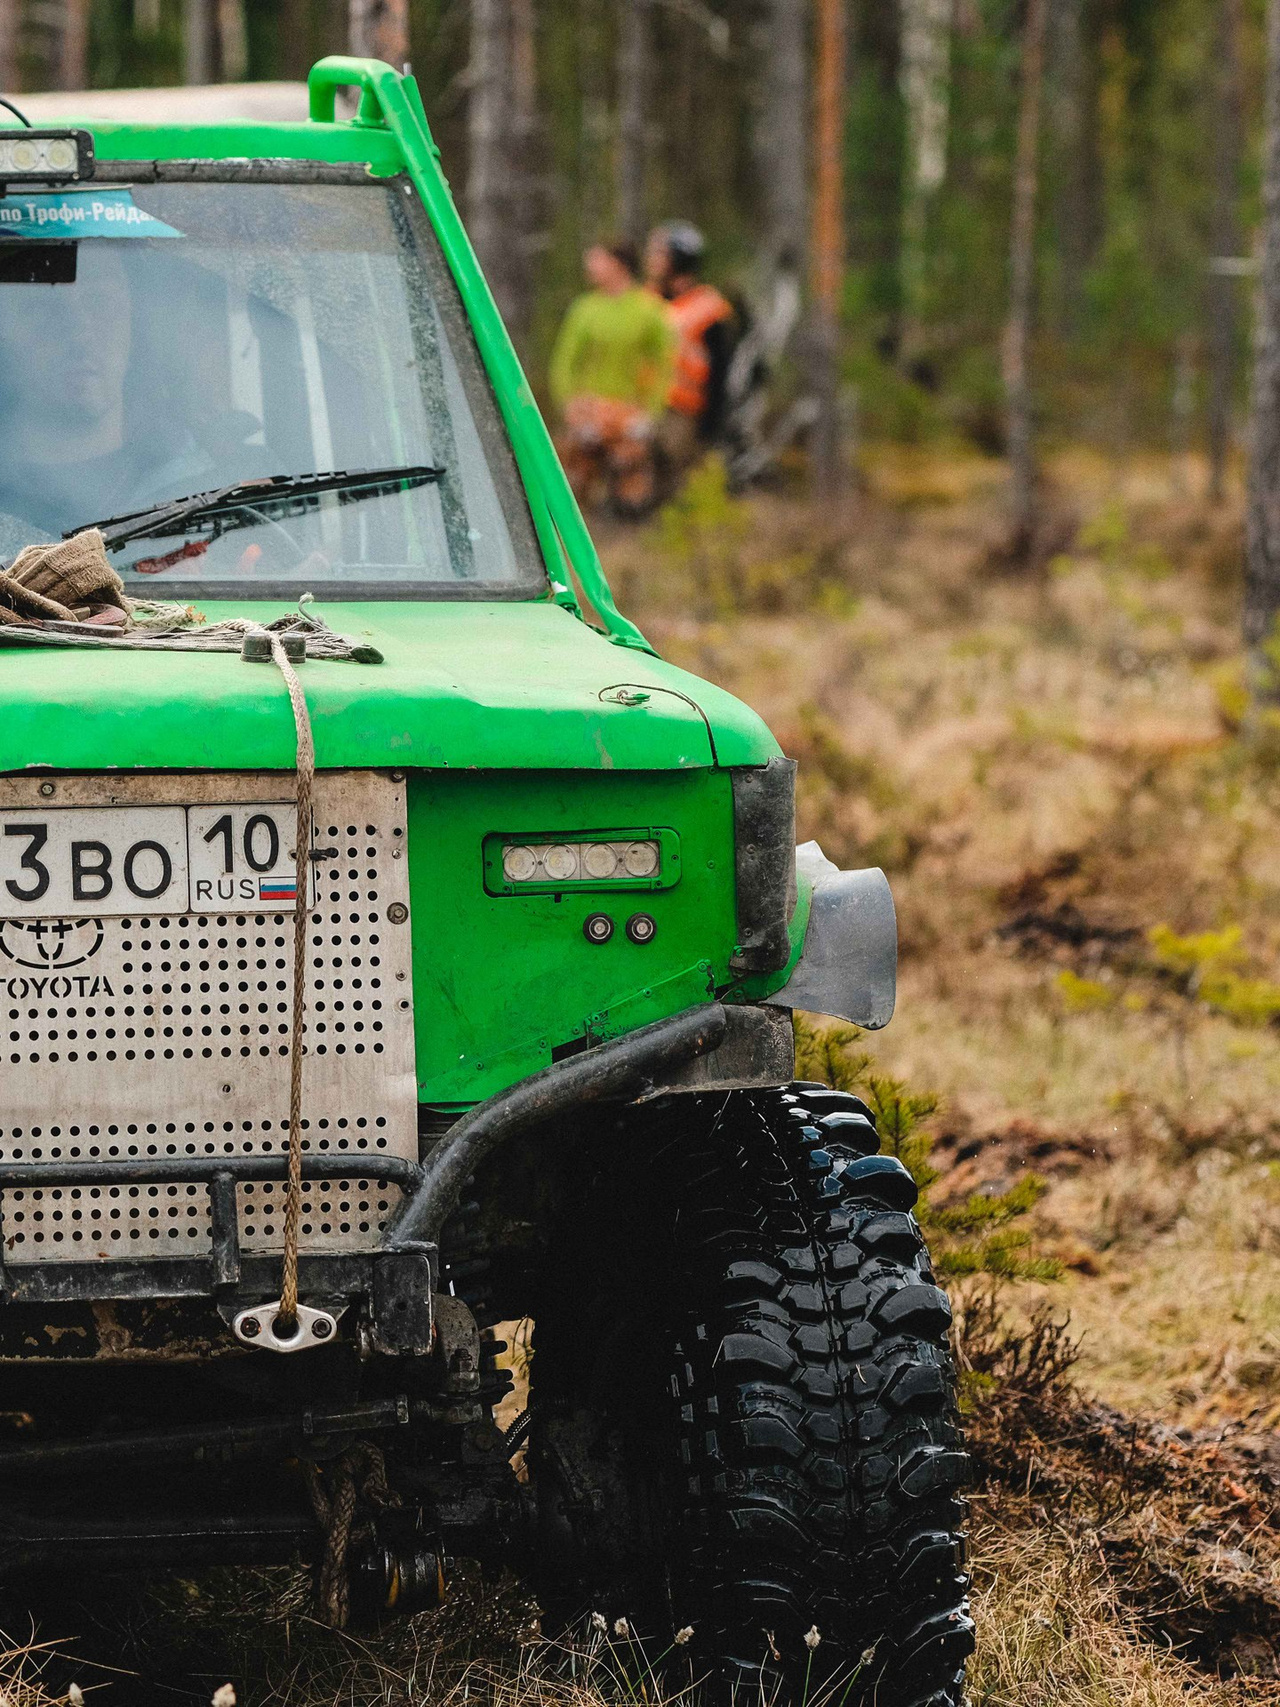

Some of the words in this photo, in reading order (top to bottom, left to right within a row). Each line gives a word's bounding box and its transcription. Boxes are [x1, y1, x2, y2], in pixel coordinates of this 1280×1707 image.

[0, 208, 22, 222] по
[202, 814, 280, 874] 10
[196, 879, 256, 901] RUS
